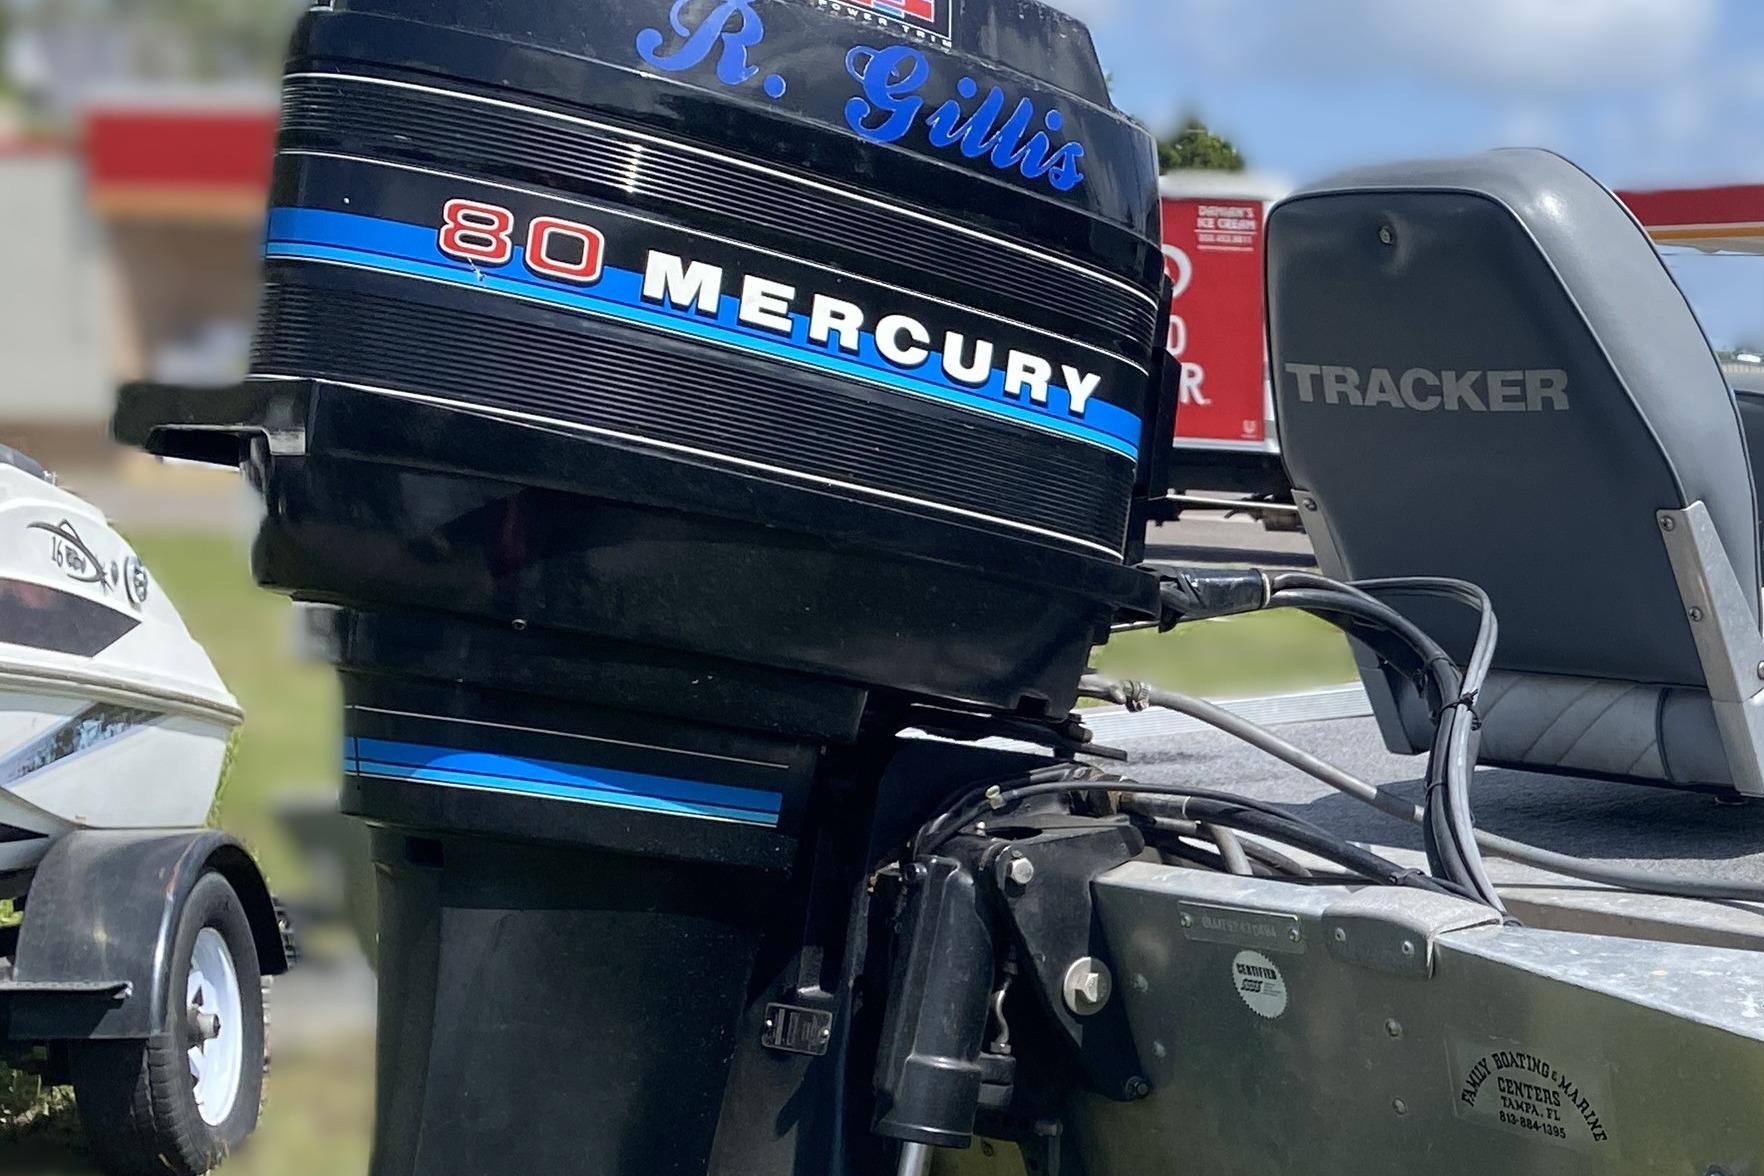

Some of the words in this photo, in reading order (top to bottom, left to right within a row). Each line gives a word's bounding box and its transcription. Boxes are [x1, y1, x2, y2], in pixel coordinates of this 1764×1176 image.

[818, 0, 888, 27] POWER
[902, 24, 952, 49] TRIM
[845, 43, 1085, 192] Gillis
[436, 198, 605, 284] 80
[642, 250, 1102, 416] MERCURY
[1284, 361, 1569, 413] TRACKER
[1461, 1057, 1491, 1107] FAMILY
[1491, 1051, 1551, 1079] BOATING
[1558, 1075, 1608, 1142] MARINE
[1497, 1076, 1561, 1107] CENTERS
[1546, 1107, 1561, 1121] FL
[1499, 1110, 1567, 1139] 813-884-1395
